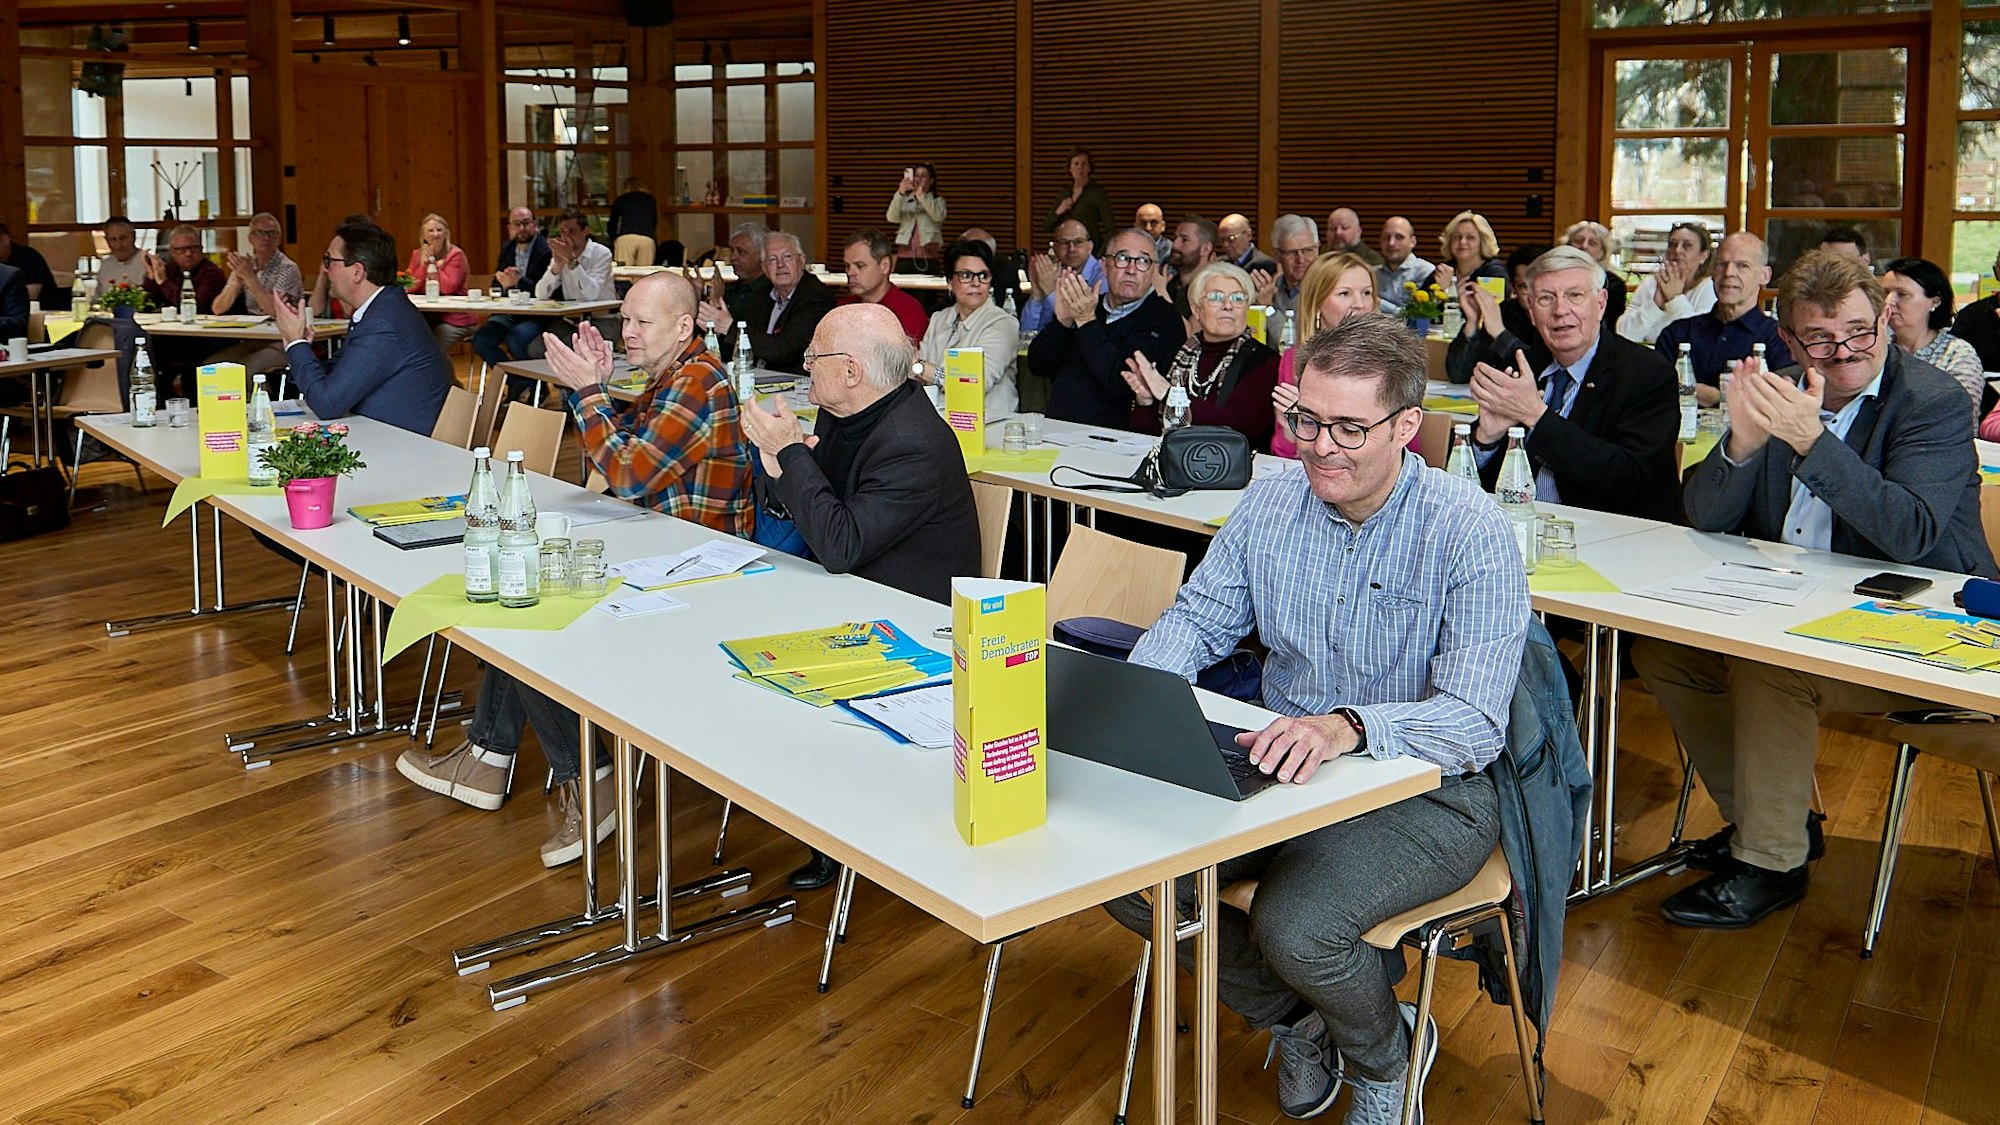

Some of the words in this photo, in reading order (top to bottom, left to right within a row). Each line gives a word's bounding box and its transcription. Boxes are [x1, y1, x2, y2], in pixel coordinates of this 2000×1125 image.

[981, 633, 1006, 648] Freie
[981, 638, 1040, 660] Demokraten
[1024, 650, 1039, 662] FDP
